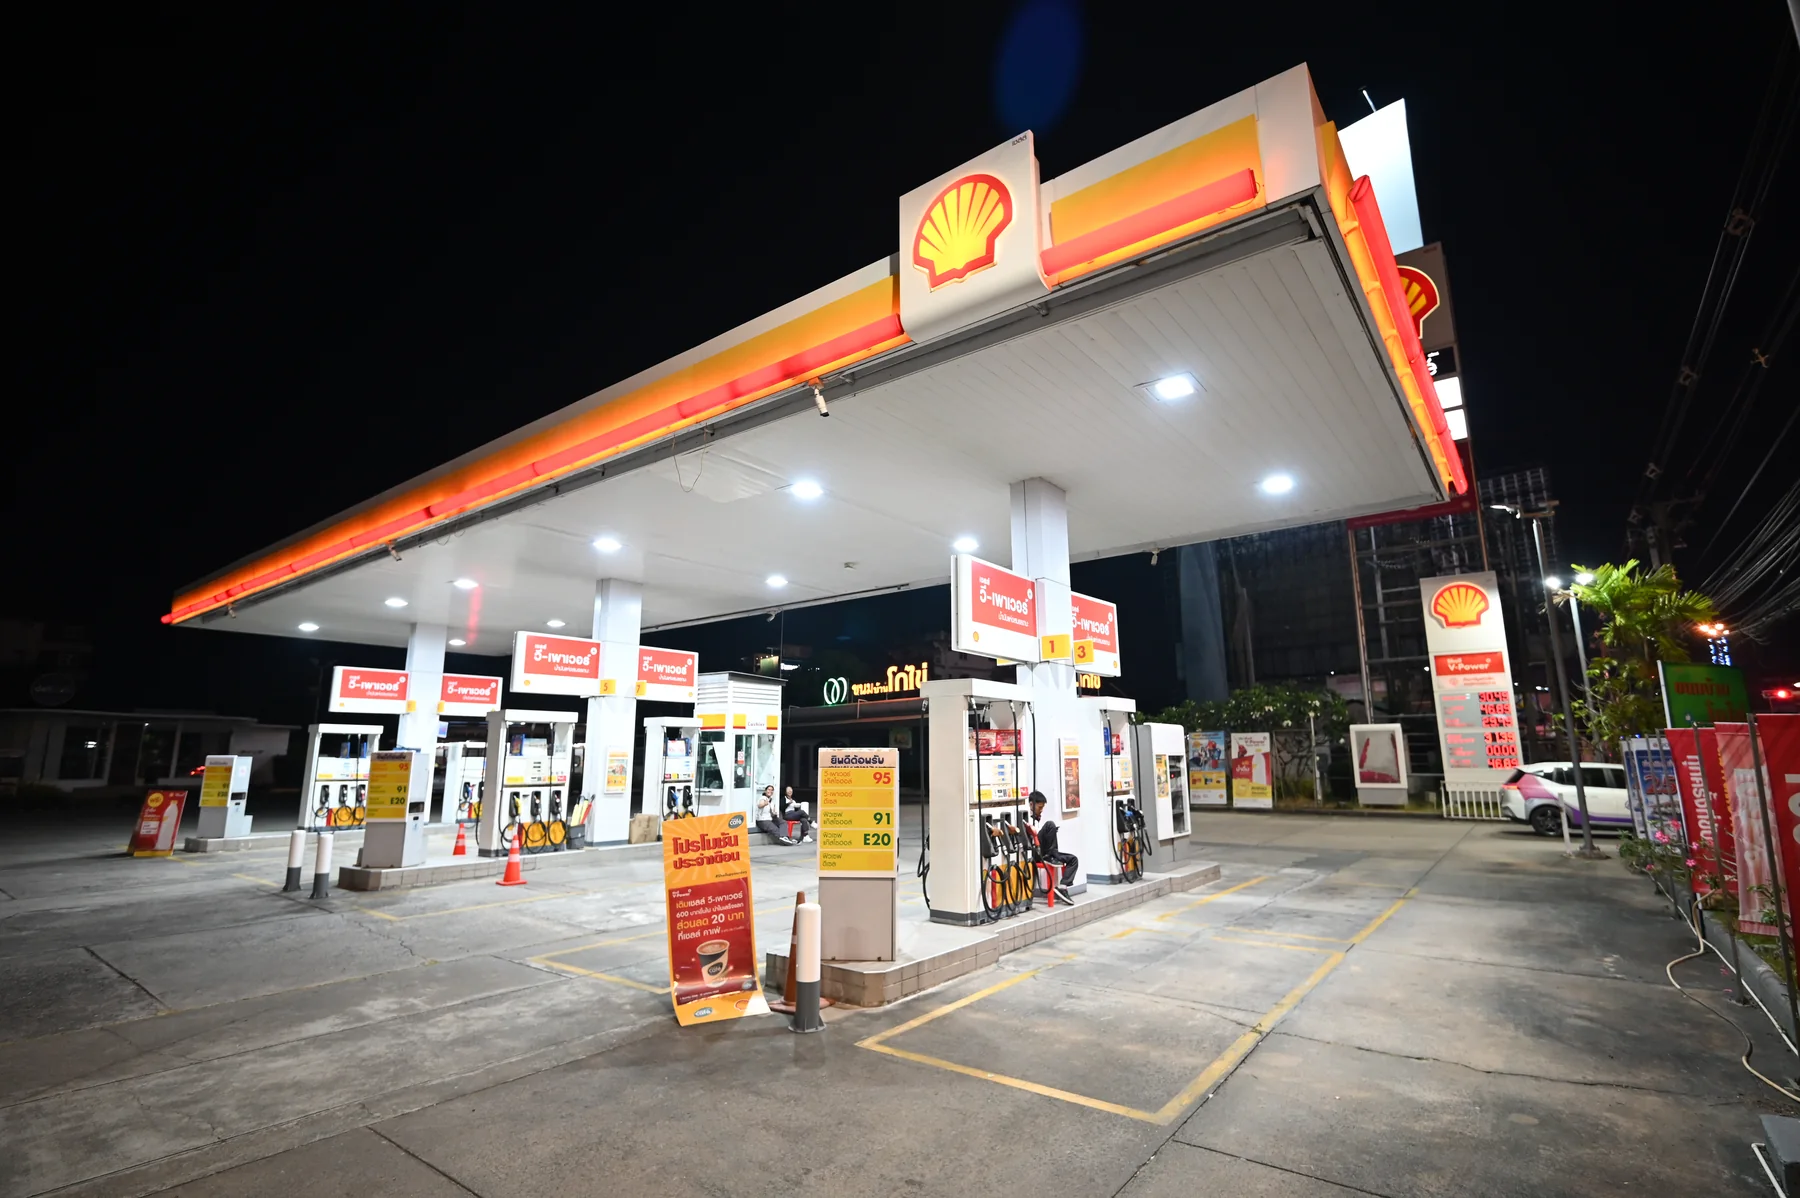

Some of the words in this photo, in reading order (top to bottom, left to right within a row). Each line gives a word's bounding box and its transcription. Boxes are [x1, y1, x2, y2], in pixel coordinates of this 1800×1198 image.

[979, 584, 1029, 616] วี-เพาเวอร์
[1049, 640, 1055, 653] 1
[1077, 645, 1086, 659] 3
[534, 649, 592, 666] วี-เพาเวอร์
[1448, 663, 1489, 671] V-Power
[603, 683, 608, 691] 5
[831, 754, 884, 765] ยินดีต้อนรับ
[398, 762, 409, 771] 95
[873, 772, 891, 784] 95
[397, 785, 407, 793] 91
[390, 797, 406, 805] E20
[873, 812, 891, 825] 91
[863, 833, 891, 846] E20
[673, 850, 740, 869] ประจำเดือน
[708, 891, 743, 904] วี-เพาเวอร์
[676, 918, 709, 930] ส่วนลด
[711, 913, 725, 924] 20
[728, 911, 744, 921] บาท
